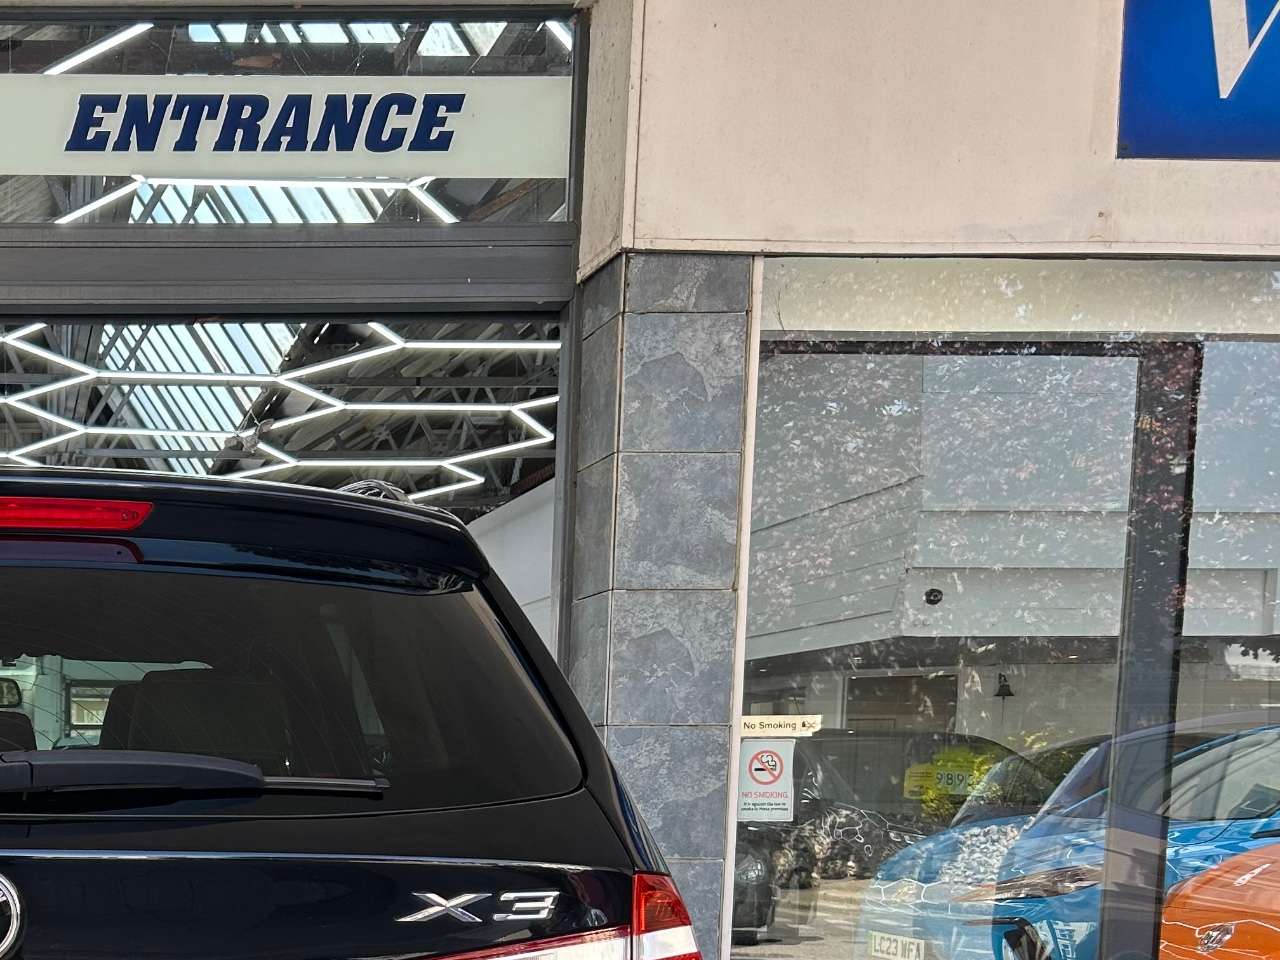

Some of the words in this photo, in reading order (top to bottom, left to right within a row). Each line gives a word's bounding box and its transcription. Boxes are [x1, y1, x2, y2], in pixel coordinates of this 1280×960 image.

[64, 93, 466, 152] ENTRANCE
[743, 721, 756, 730] No
[759, 721, 797, 730] Smoking
[395, 891, 561, 922] X3
